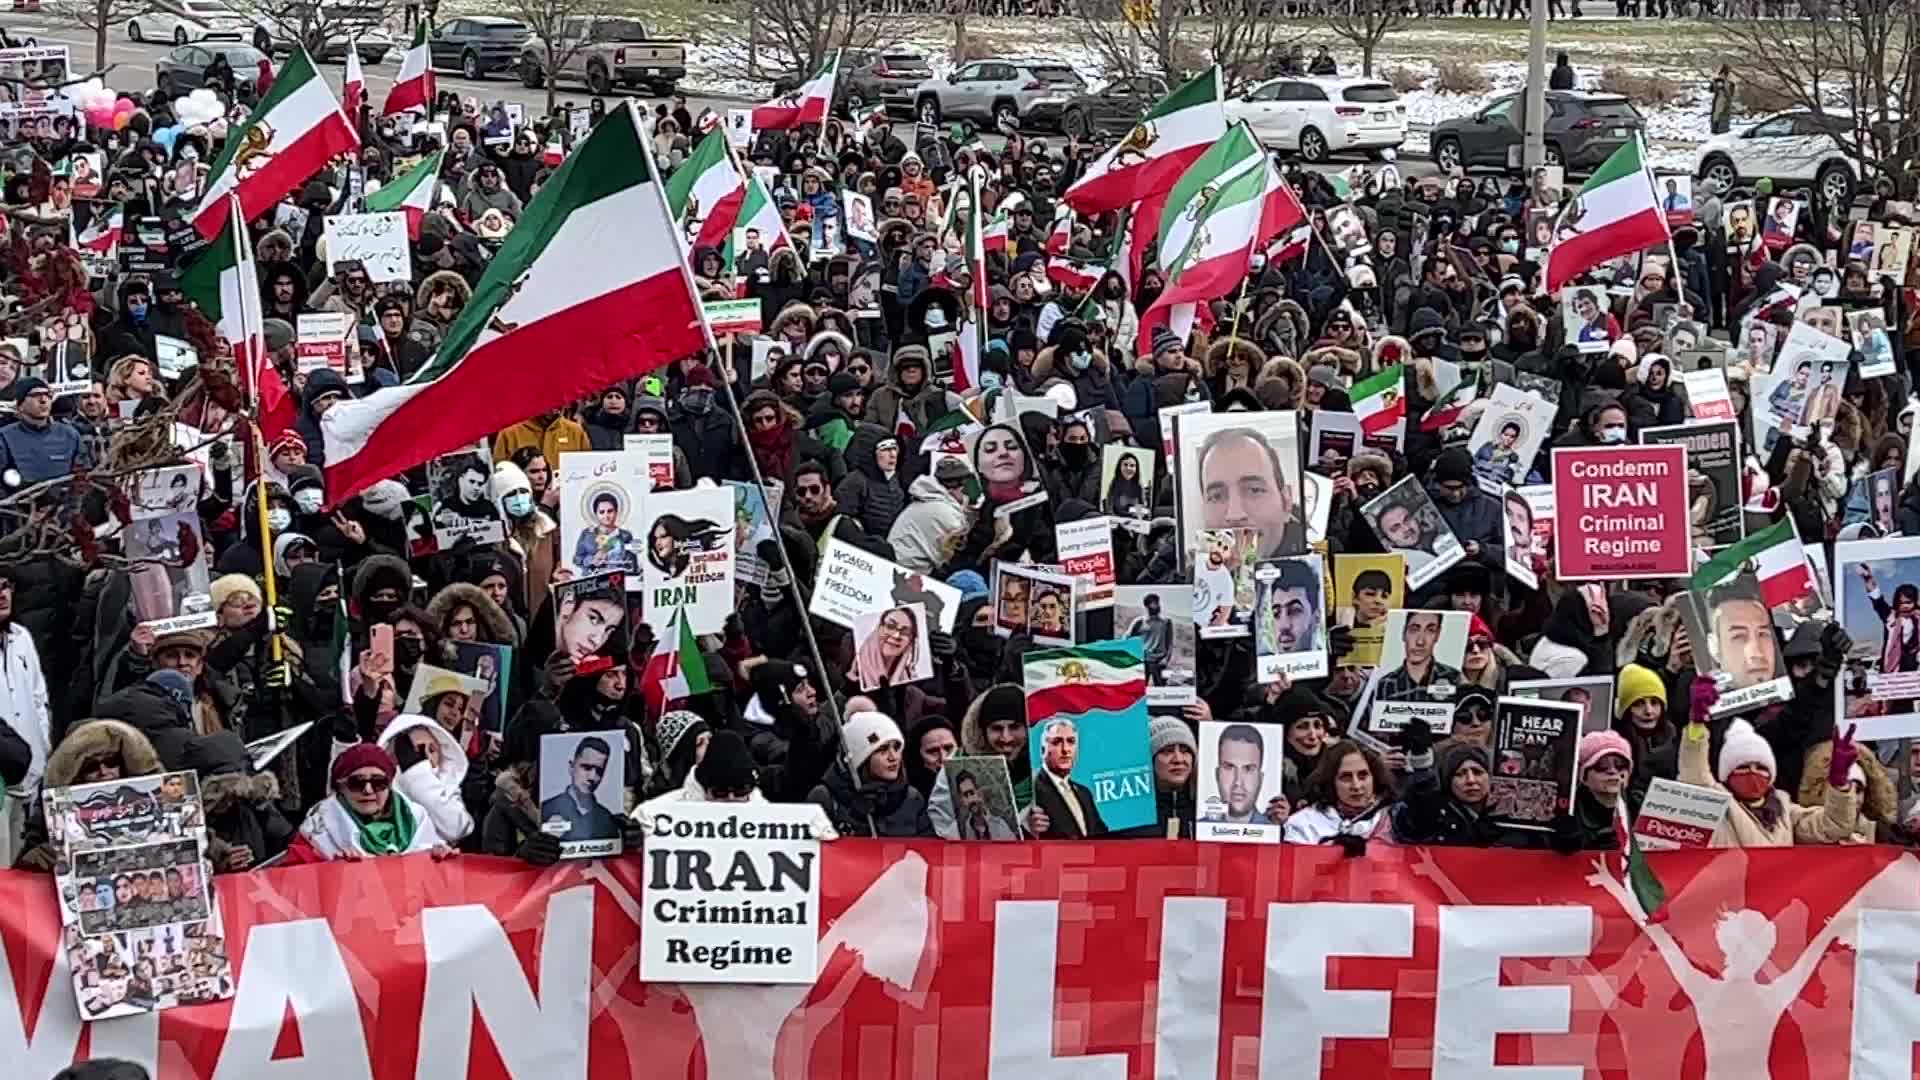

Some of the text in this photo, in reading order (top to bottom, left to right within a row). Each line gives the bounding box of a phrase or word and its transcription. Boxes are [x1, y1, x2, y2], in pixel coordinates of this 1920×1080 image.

[1570, 459, 1669, 478] Condemn
[1582, 482, 1658, 509] IRAN
[1579, 513, 1665, 533] Criminal
[1584, 536, 1662, 558] Regime
[1066, 556, 1106, 572] People
[654, 585, 697, 608] IRAN
[825, 577, 873, 604] FREEDOM
[1521, 714, 1564, 733] HEAR
[1094, 774, 1151, 803] IRAN
[653, 813, 814, 841] Condemn
[1646, 819, 1705, 842] People
[648, 848, 815, 893] IRAN
[653, 897, 808, 925] Criminal
[665, 938, 793, 971] Regime
[986, 896, 1594, 1080] LIFE
